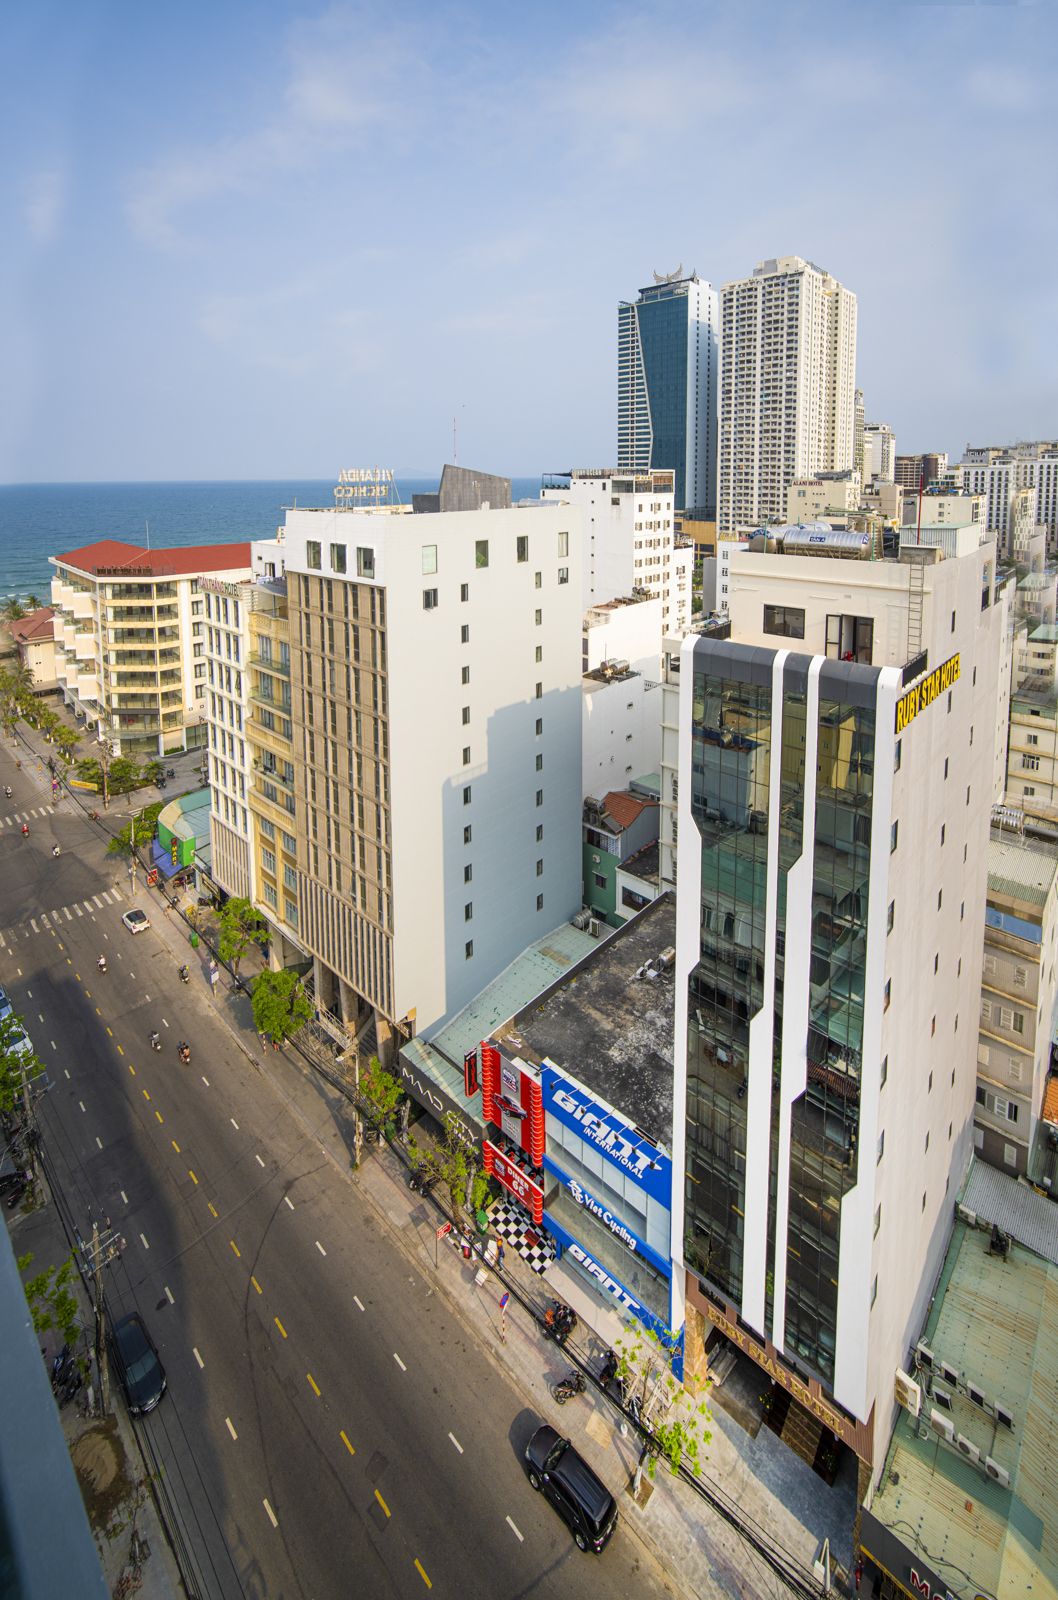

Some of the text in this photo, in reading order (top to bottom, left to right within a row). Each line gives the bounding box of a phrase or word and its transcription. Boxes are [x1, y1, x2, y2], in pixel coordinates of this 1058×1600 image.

[896, 652, 961, 734] RUBY STAR HOTEL
[552, 1089, 662, 1171] GIANT
[584, 1126, 643, 1179] INTERNATIONAL
[507, 1165, 529, 1192] DINER
[512, 1180, 525, 1196] 66
[603, 1211, 637, 1250] Cycling
[568, 1243, 641, 1310] GIANT
[707, 1304, 844, 1437] RUBY STAR HOTEL
